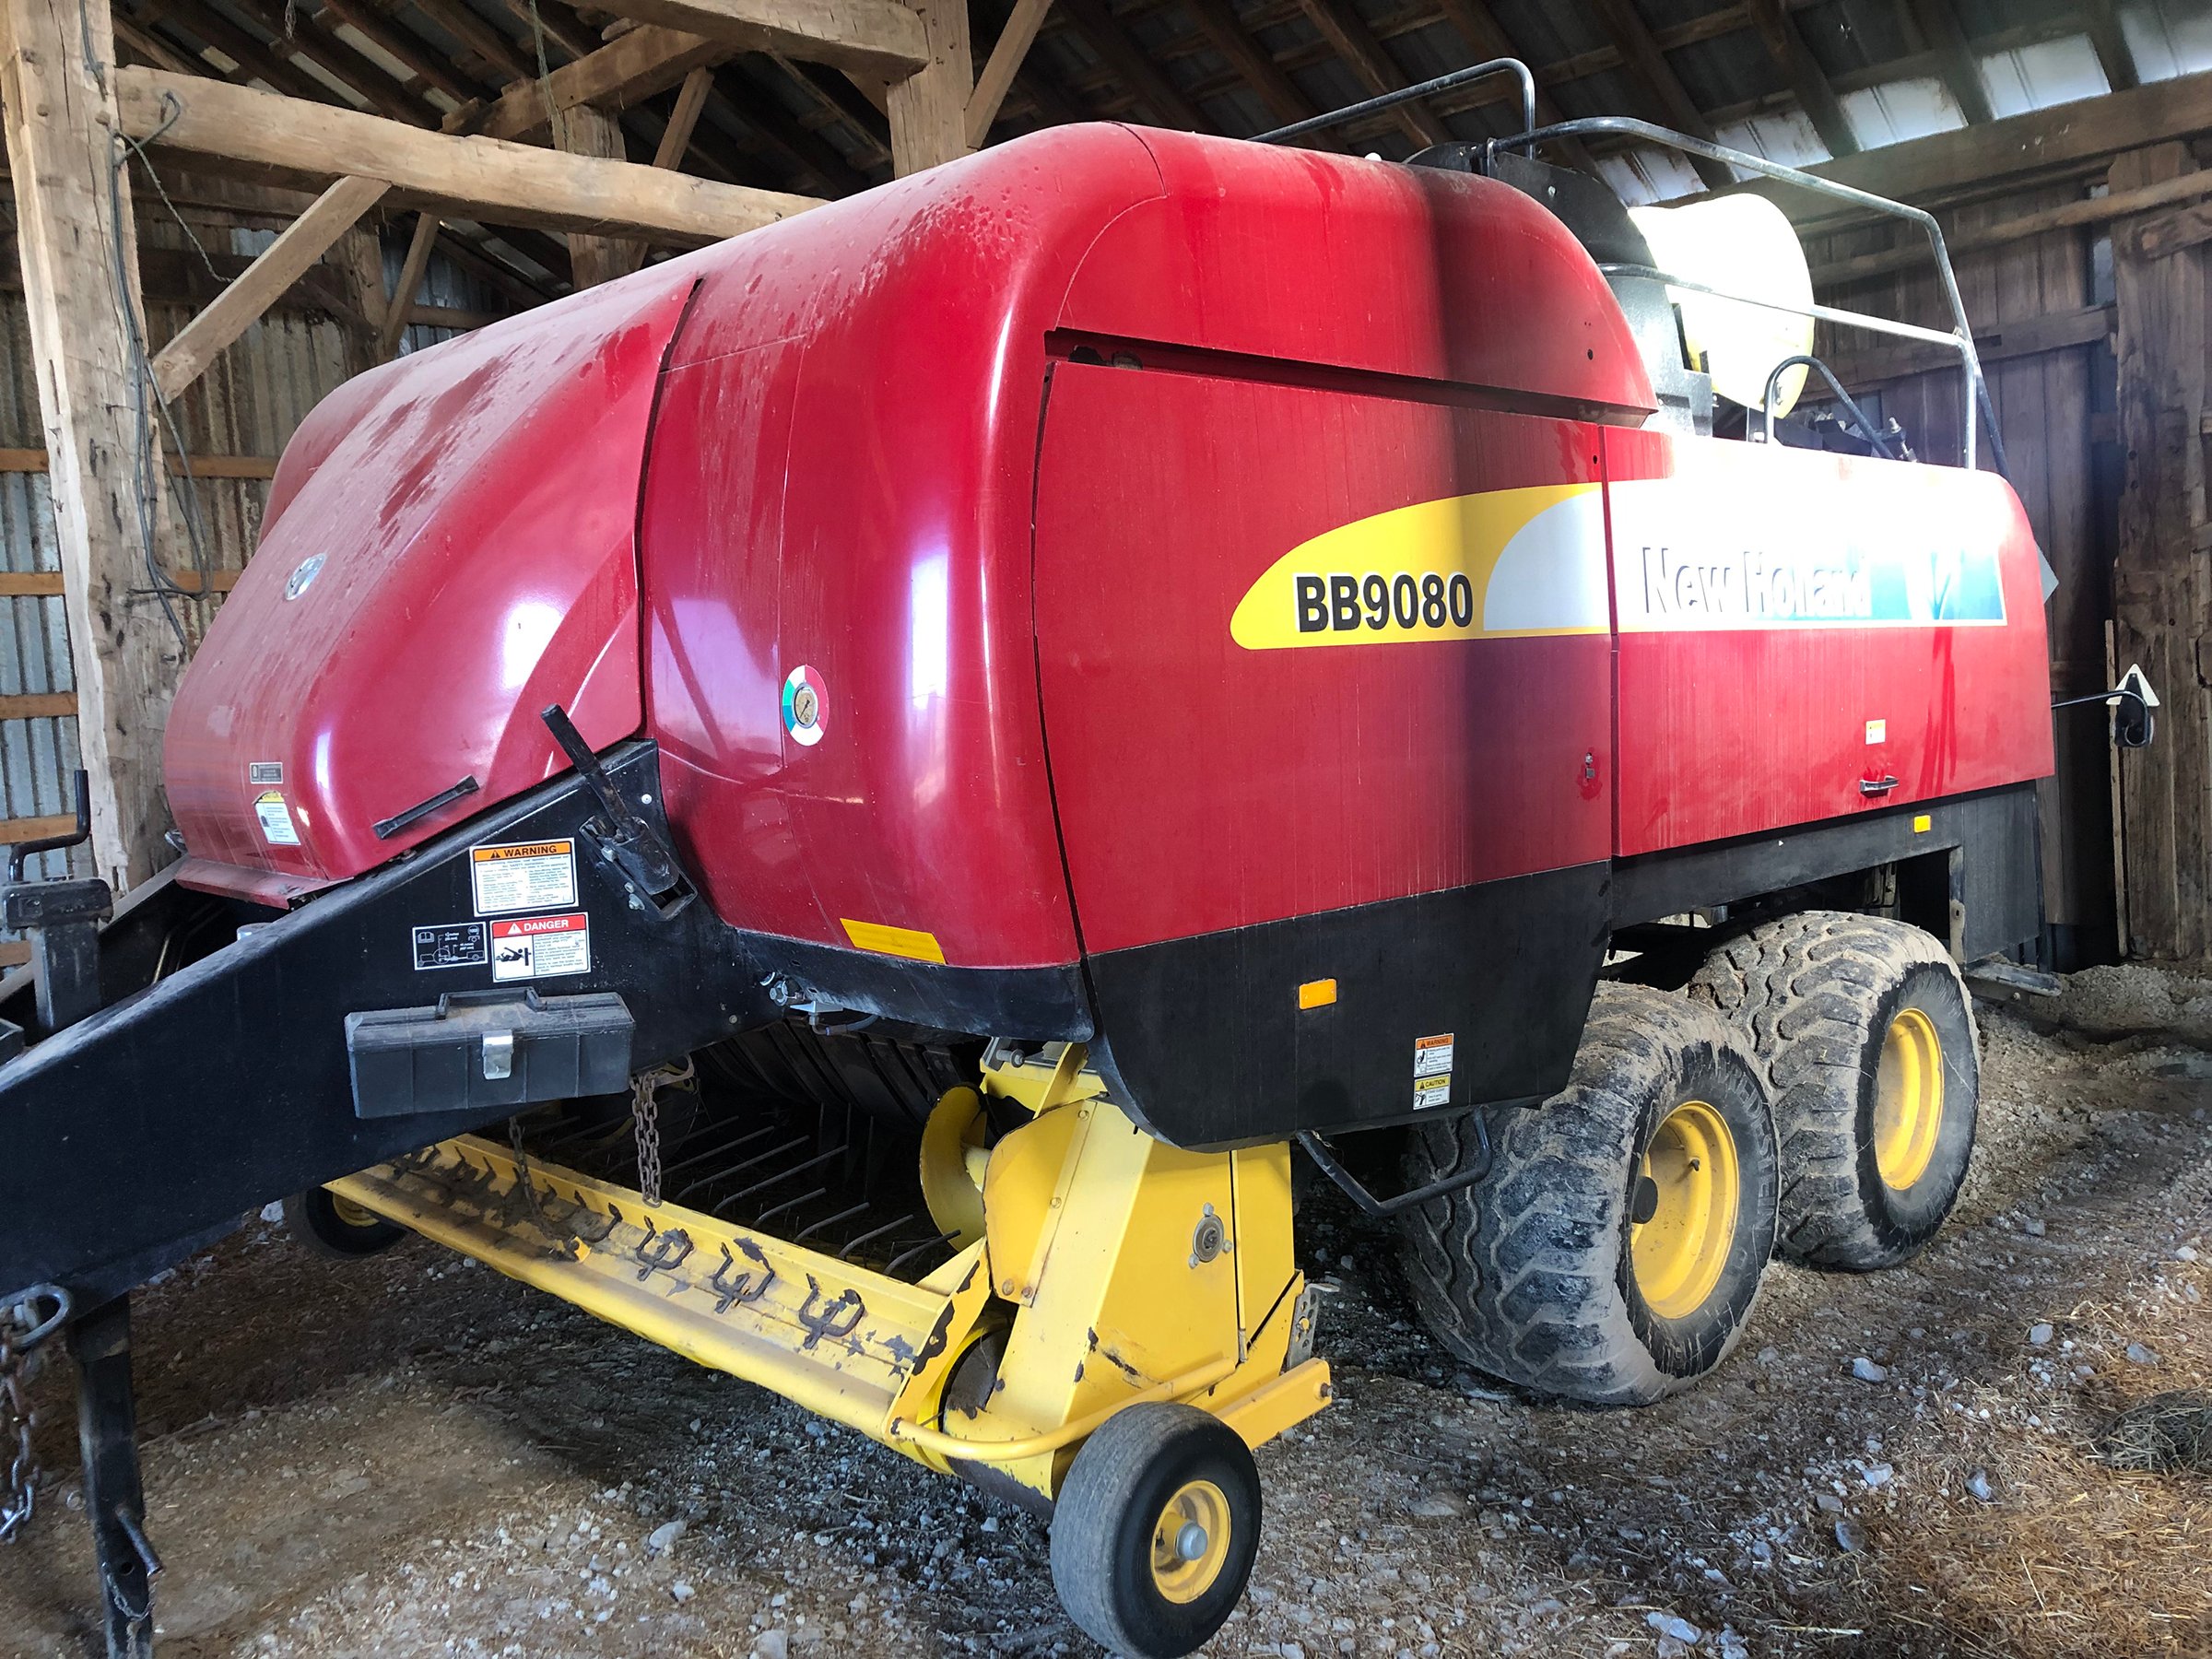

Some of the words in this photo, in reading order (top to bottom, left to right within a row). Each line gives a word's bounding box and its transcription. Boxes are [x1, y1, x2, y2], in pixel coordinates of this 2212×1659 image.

[1642, 547, 1737, 615] New
[1295, 573, 1474, 632] BB9080
[503, 844, 557, 857] WARNING
[523, 919, 570, 933] DANGER
[1427, 1038, 1449, 1046] WARNING
[1425, 1079, 1445, 1088] CAUTION
